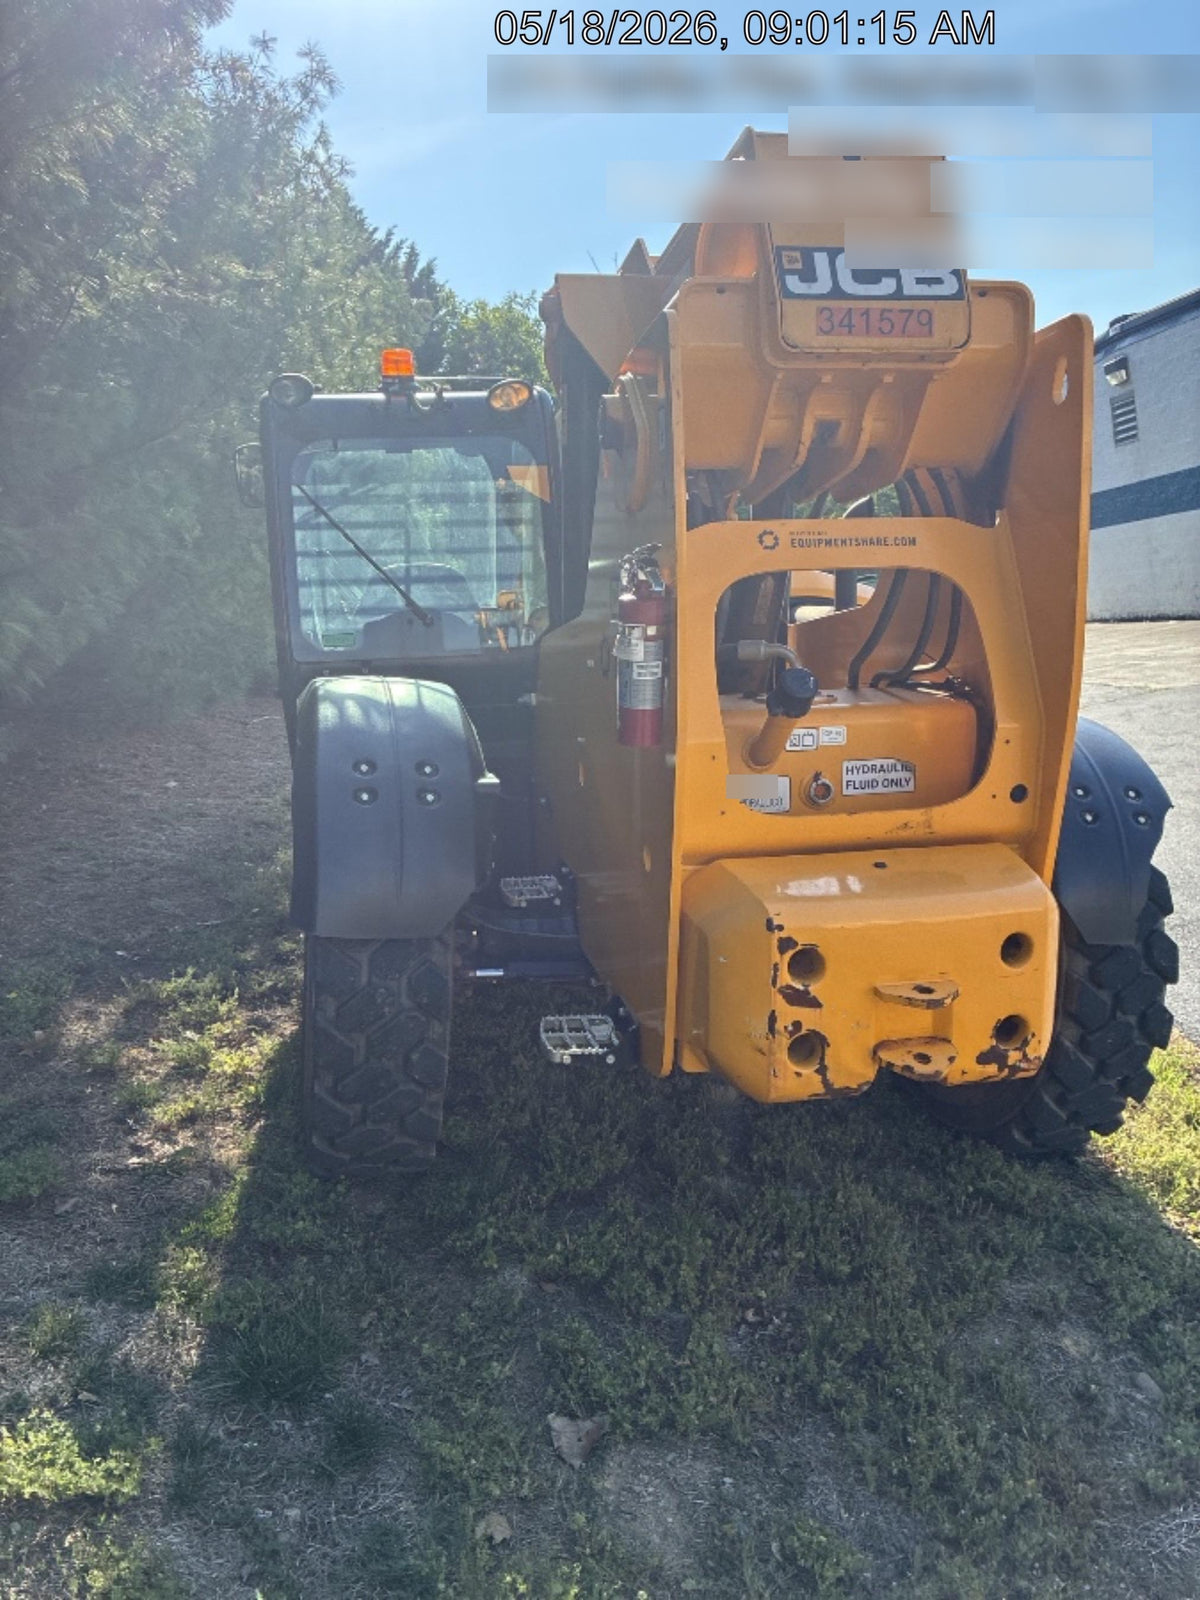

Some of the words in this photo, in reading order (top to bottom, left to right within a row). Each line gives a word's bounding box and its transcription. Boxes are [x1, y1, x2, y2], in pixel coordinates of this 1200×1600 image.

[819, 306, 933, 336] 341579
[790, 537, 917, 548] EQUIPMENTSHARE.COM
[846, 779, 879, 790] FLUID
[881, 777, 912, 789] ONLY
